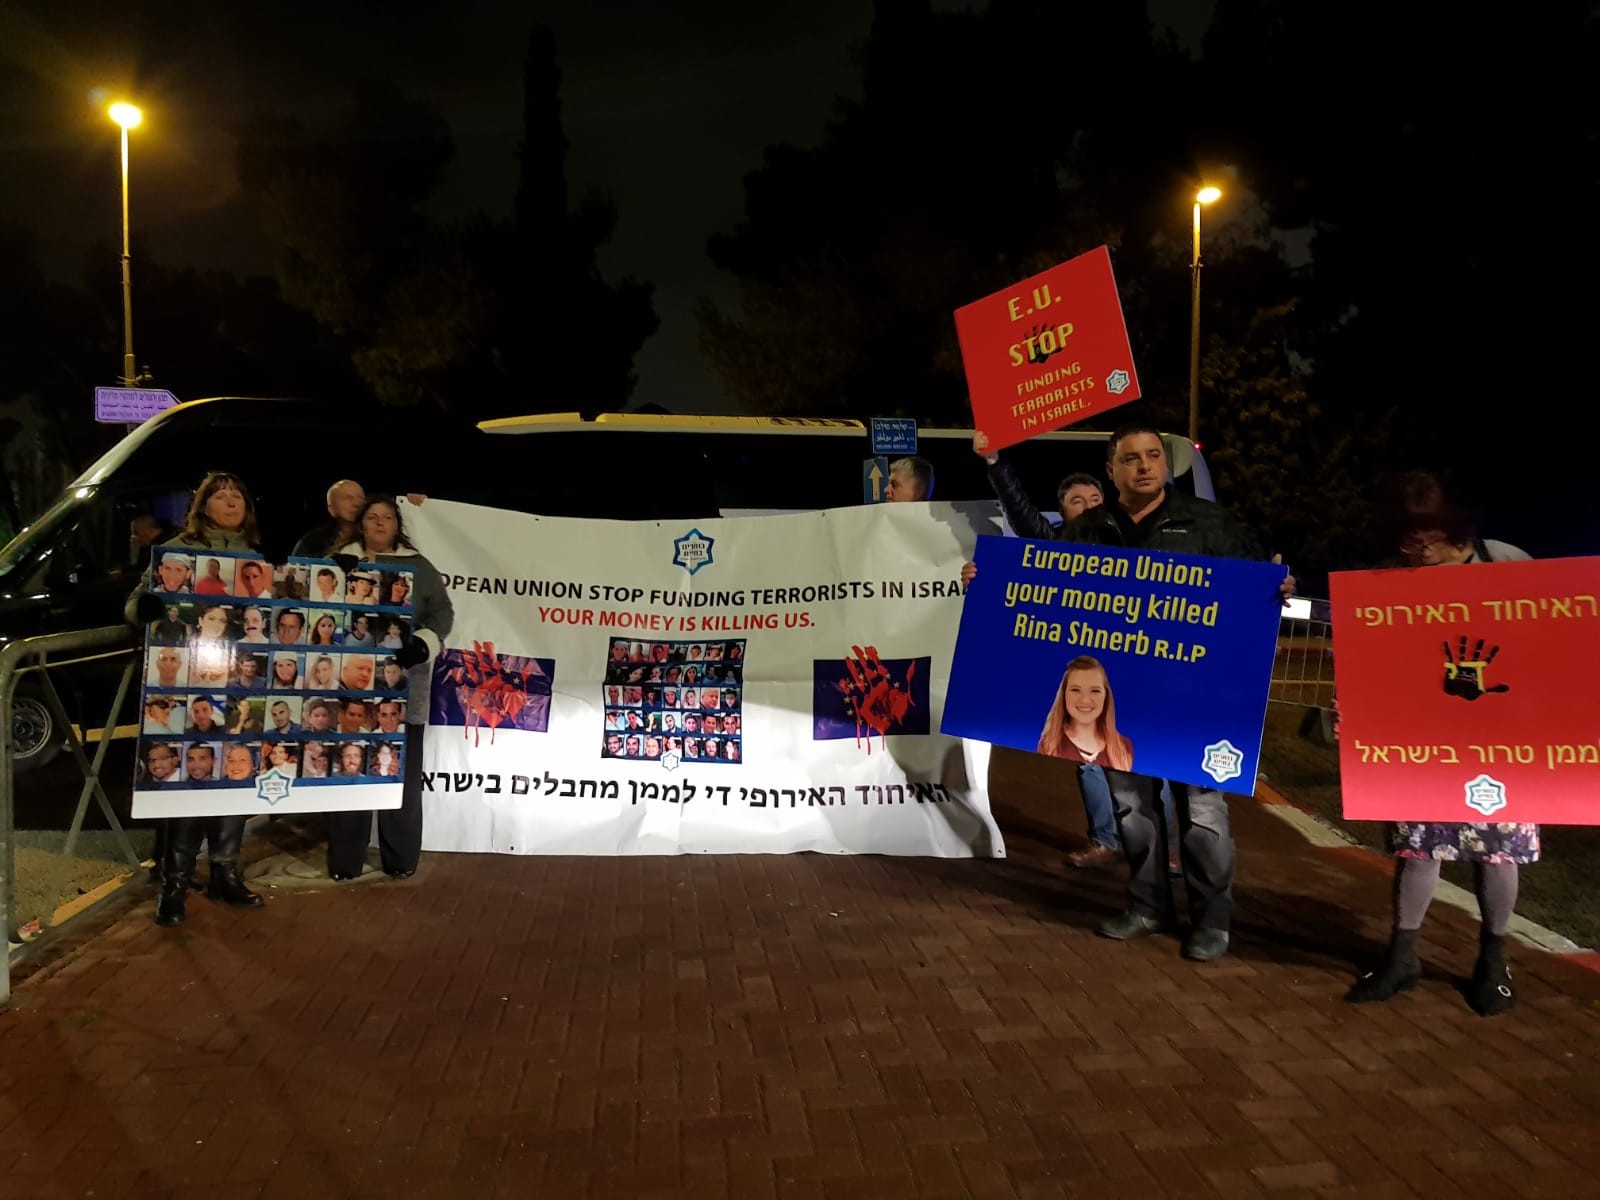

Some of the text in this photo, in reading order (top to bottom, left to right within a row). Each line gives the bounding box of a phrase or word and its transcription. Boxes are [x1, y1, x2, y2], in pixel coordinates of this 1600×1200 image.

[1007, 284, 1062, 322] E.U.
[1008, 322, 1074, 367] STOP
[1011, 376, 1095, 418] TERRORISTS
[1016, 361, 1082, 396] FUNDING
[1022, 398, 1092, 430] IN ISRAEL.
[1021, 544, 1213, 588] European Union:
[440, 573, 967, 608] OPEAN UNION STOP FUNDING TERRORISTS IN ISRA
[1004, 581, 1219, 627] your money killed
[538, 606, 816, 632] YOUR MONEY IS KILLING US.
[1355, 595, 1600, 627] האיחוד האירופי
[1013, 613, 1207, 663] Rina Shnerb R.I.P
[1355, 739, 1600, 770] ממן טרור בישראל
[421, 771, 951, 808] האיחוד האירופי די לממן מחבלים בישרא
